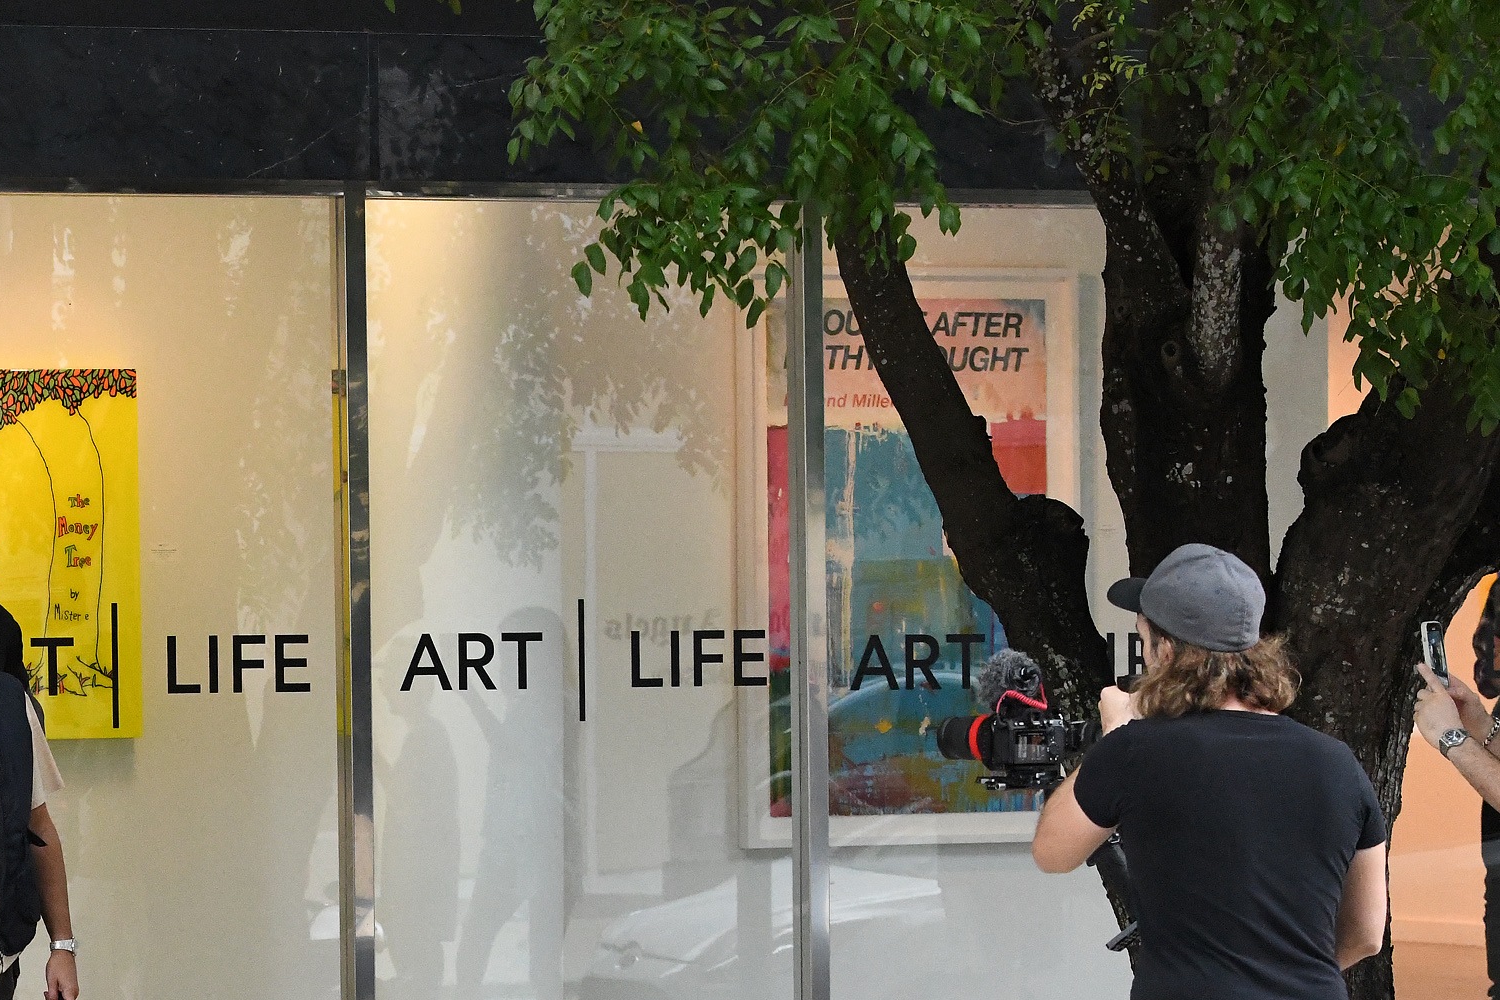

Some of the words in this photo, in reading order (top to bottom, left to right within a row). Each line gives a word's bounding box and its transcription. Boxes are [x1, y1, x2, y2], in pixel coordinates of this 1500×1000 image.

[931, 311, 1023, 338] AFTER
[68, 494, 90, 508] The
[58, 516, 98, 541] Money
[65, 544, 92, 568] Tree
[70, 589, 79, 601] by
[166, 634, 311, 694] LIFE
[400, 632, 543, 691] ART
[630, 629, 768, 688] LIFE
[850, 634, 985, 690] ART
